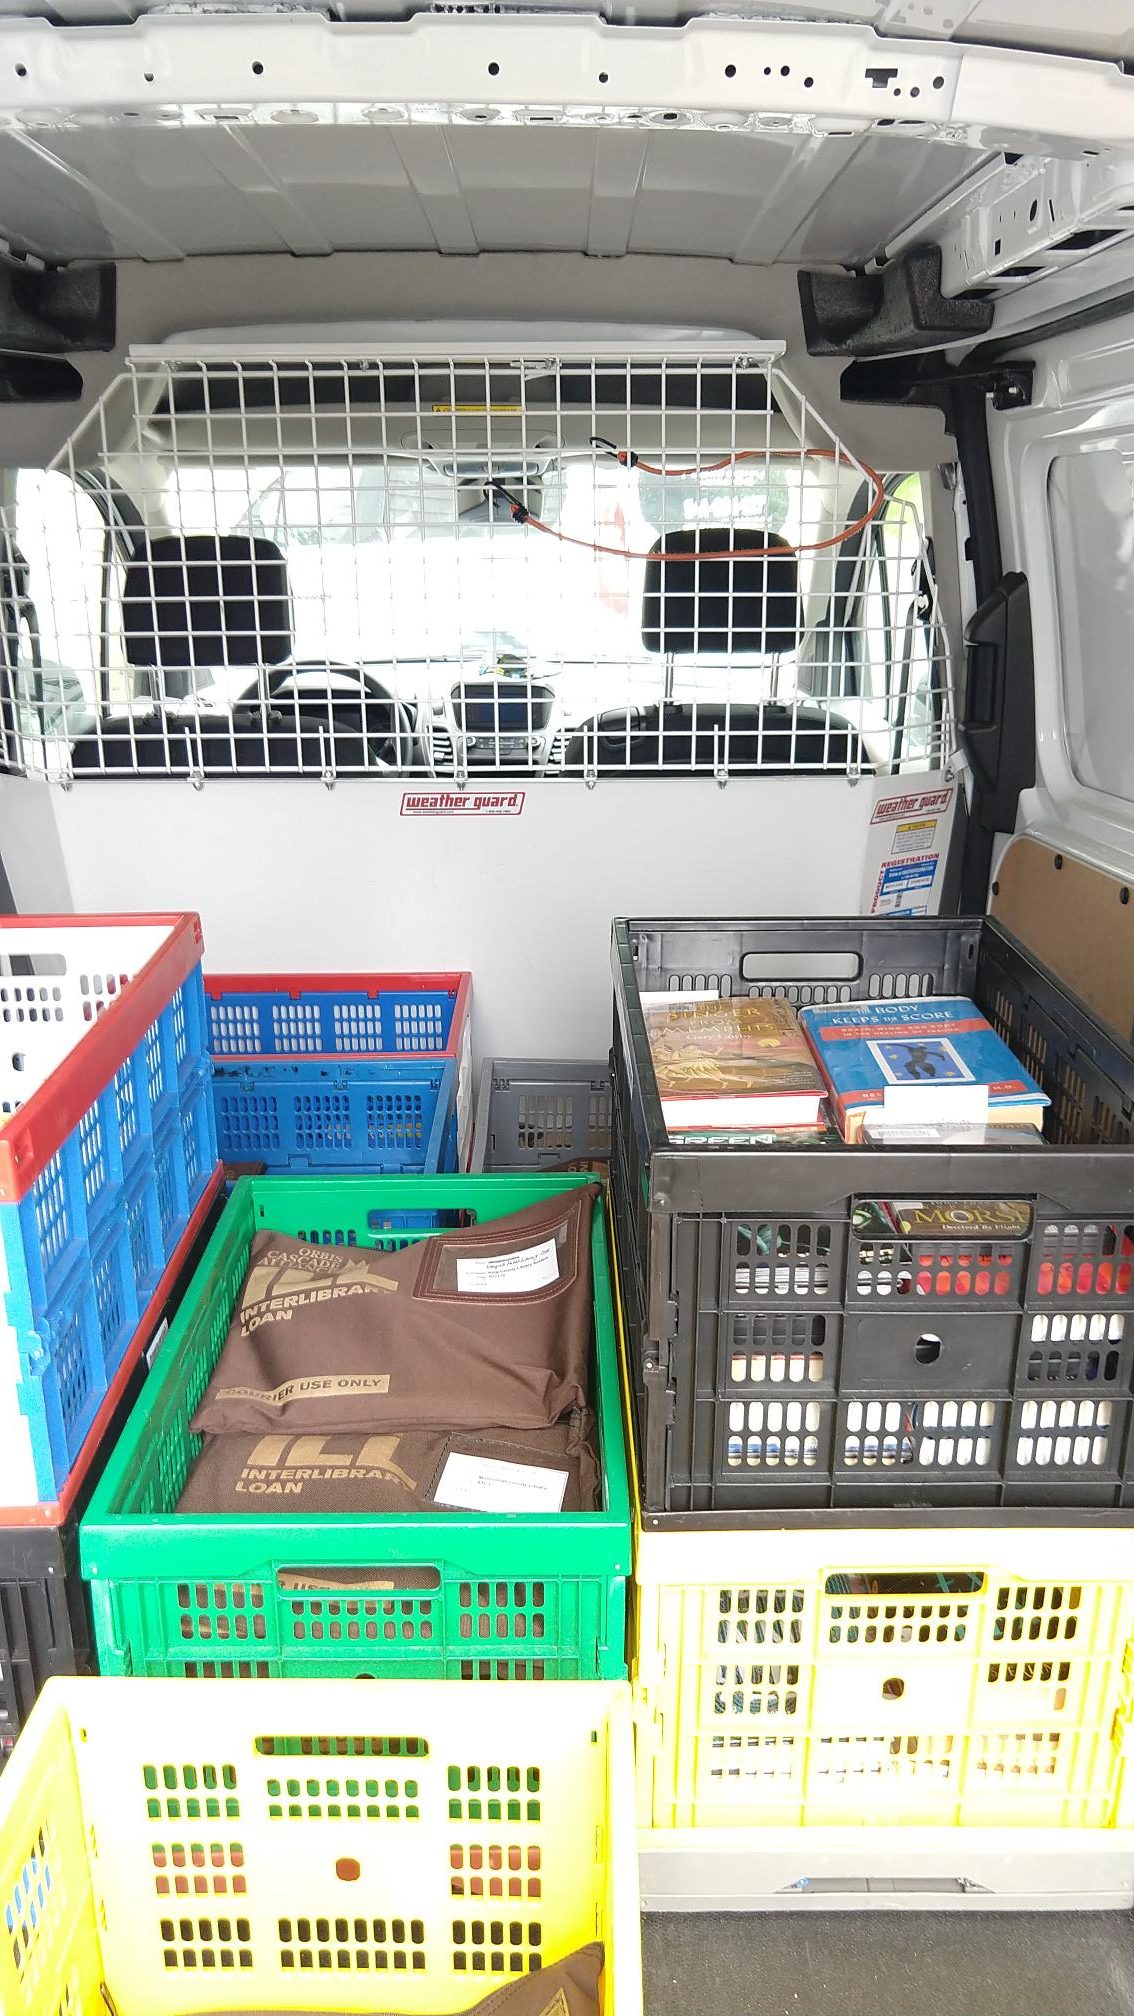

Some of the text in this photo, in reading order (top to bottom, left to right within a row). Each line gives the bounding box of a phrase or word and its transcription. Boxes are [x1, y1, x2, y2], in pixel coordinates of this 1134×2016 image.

[406, 793, 518, 810] weather guard
[877, 790, 948, 815] weather guard
[881, 852, 940, 868] REGISTRATION
[870, 870, 885, 914] PRODUCT
[667, 1006, 763, 1020] SINGER
[875, 1005, 918, 1014] BODY
[689, 1018, 743, 1027] FROM
[832, 1016, 879, 1025] KEEPS
[901, 1010, 955, 1021] SCORE
[661, 1023, 775, 1036] MEMPHIS
[267, 1250, 342, 1269] CASCADE
[298, 1247, 344, 1263] ORBIS
[239, 1309, 293, 1337] LOAN
[299, 1379, 332, 1390] USE
[337, 1378, 383, 1388] ONLY
[235, 1481, 303, 1494] LOAN
